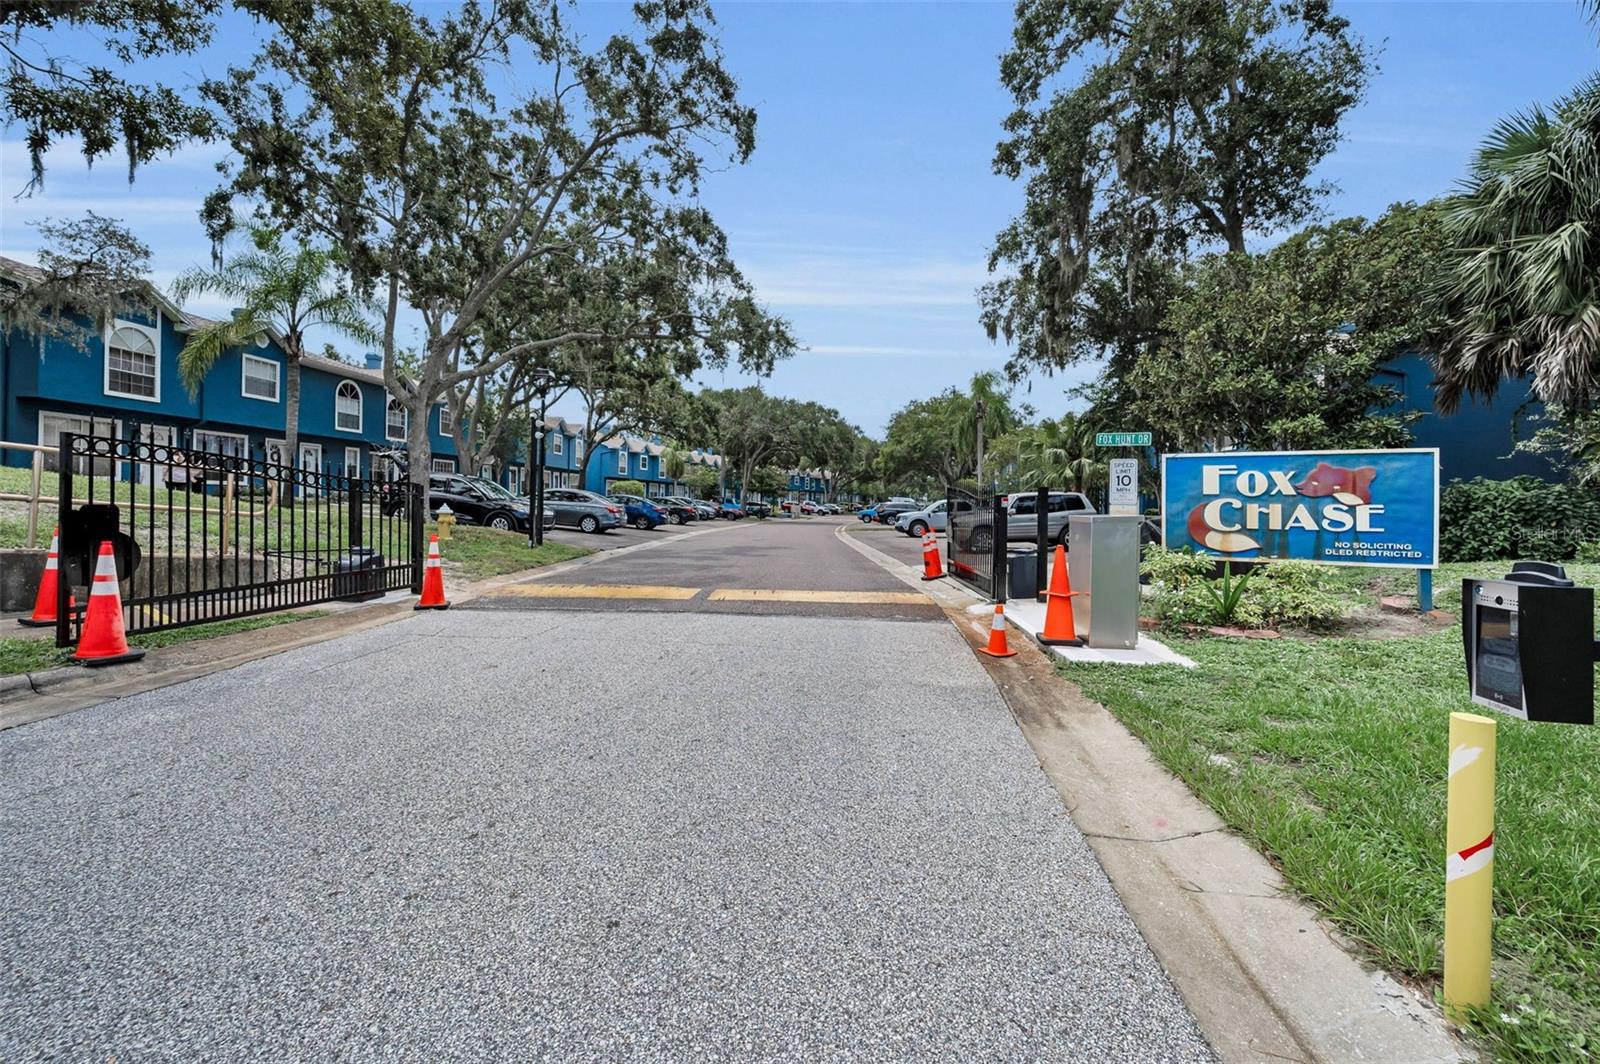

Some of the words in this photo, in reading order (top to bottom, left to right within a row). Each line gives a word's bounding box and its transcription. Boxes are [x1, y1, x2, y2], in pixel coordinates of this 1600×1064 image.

[1098, 435, 1112, 444] FOX
[1116, 435, 1136, 444] HUNT
[1138, 434, 1149, 444] DR
[1116, 475, 1132, 487] 10
[1352, 542, 1412, 550] SOLICITING
[1355, 549, 1422, 558] RESTRICTED
